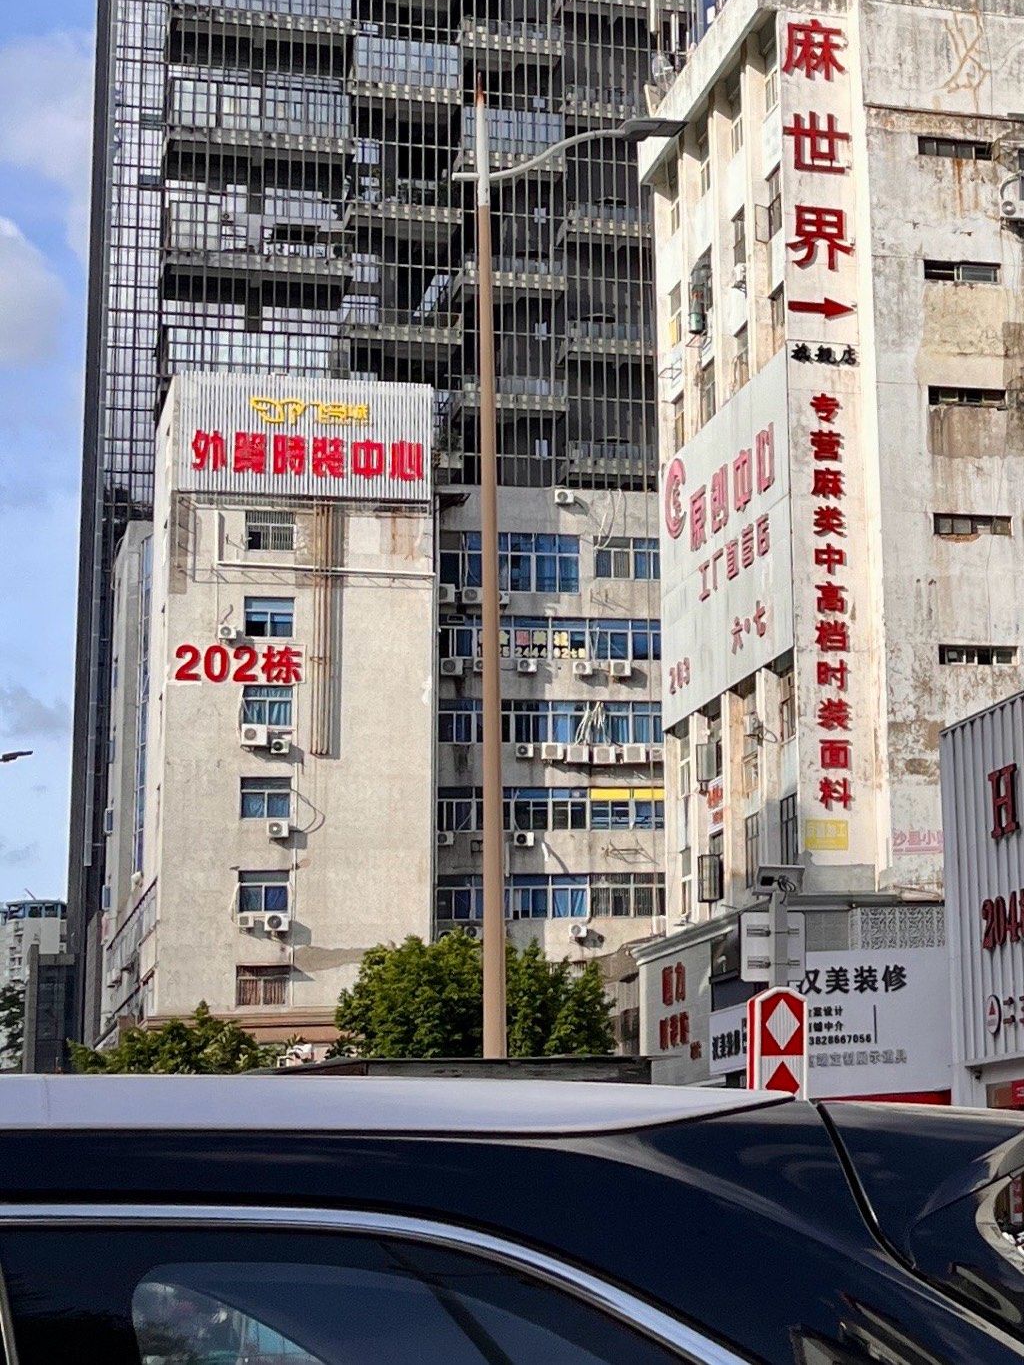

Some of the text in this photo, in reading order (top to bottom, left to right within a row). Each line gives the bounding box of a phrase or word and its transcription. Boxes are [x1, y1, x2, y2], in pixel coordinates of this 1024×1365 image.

[782, 18, 857, 272] 麻世界
[175, 644, 303, 683] 202栋
[809, 393, 852, 811] 专营麻类中高档时装面料
[987, 763, 1020, 839] H
